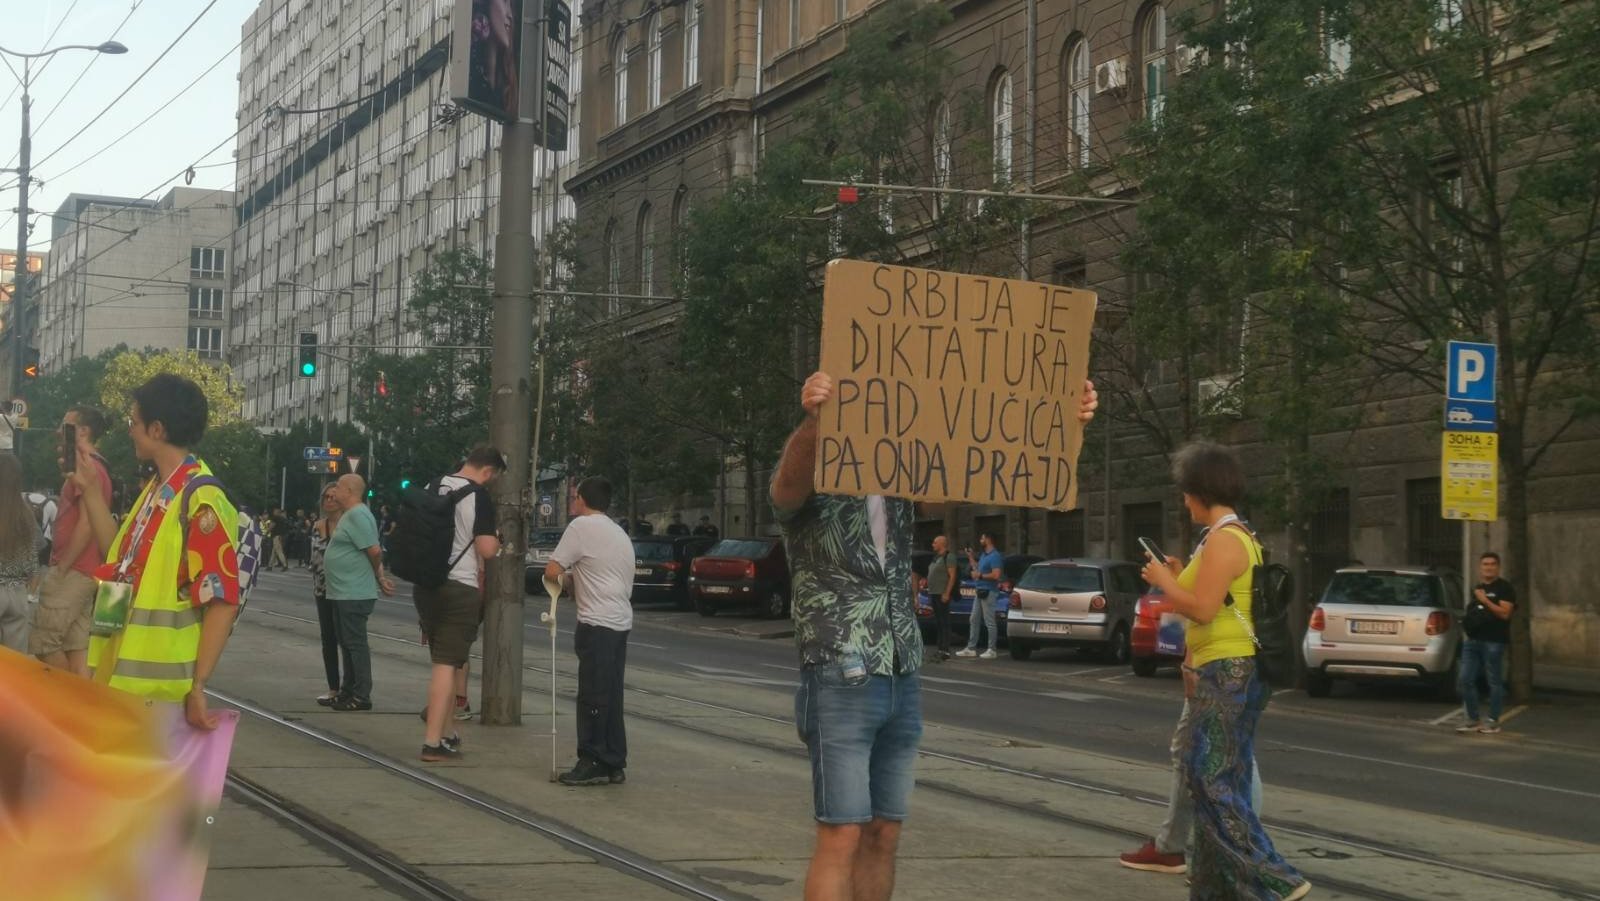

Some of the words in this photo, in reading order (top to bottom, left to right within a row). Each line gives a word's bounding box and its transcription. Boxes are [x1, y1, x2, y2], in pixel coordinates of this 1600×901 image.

[867, 266, 1014, 327] SRBIJA
[1035, 286, 1073, 334] JE
[1457, 349, 1485, 393] P
[838, 378, 919, 438] PAD
[939, 386, 1065, 452] VUČIĆA
[1448, 433, 1480, 445] ЗОНА
[1487, 435, 1494, 446] 2
[821, 436, 864, 490] PA
[874, 438, 948, 497] ONDA
[964, 446, 1071, 506] PRAJD
